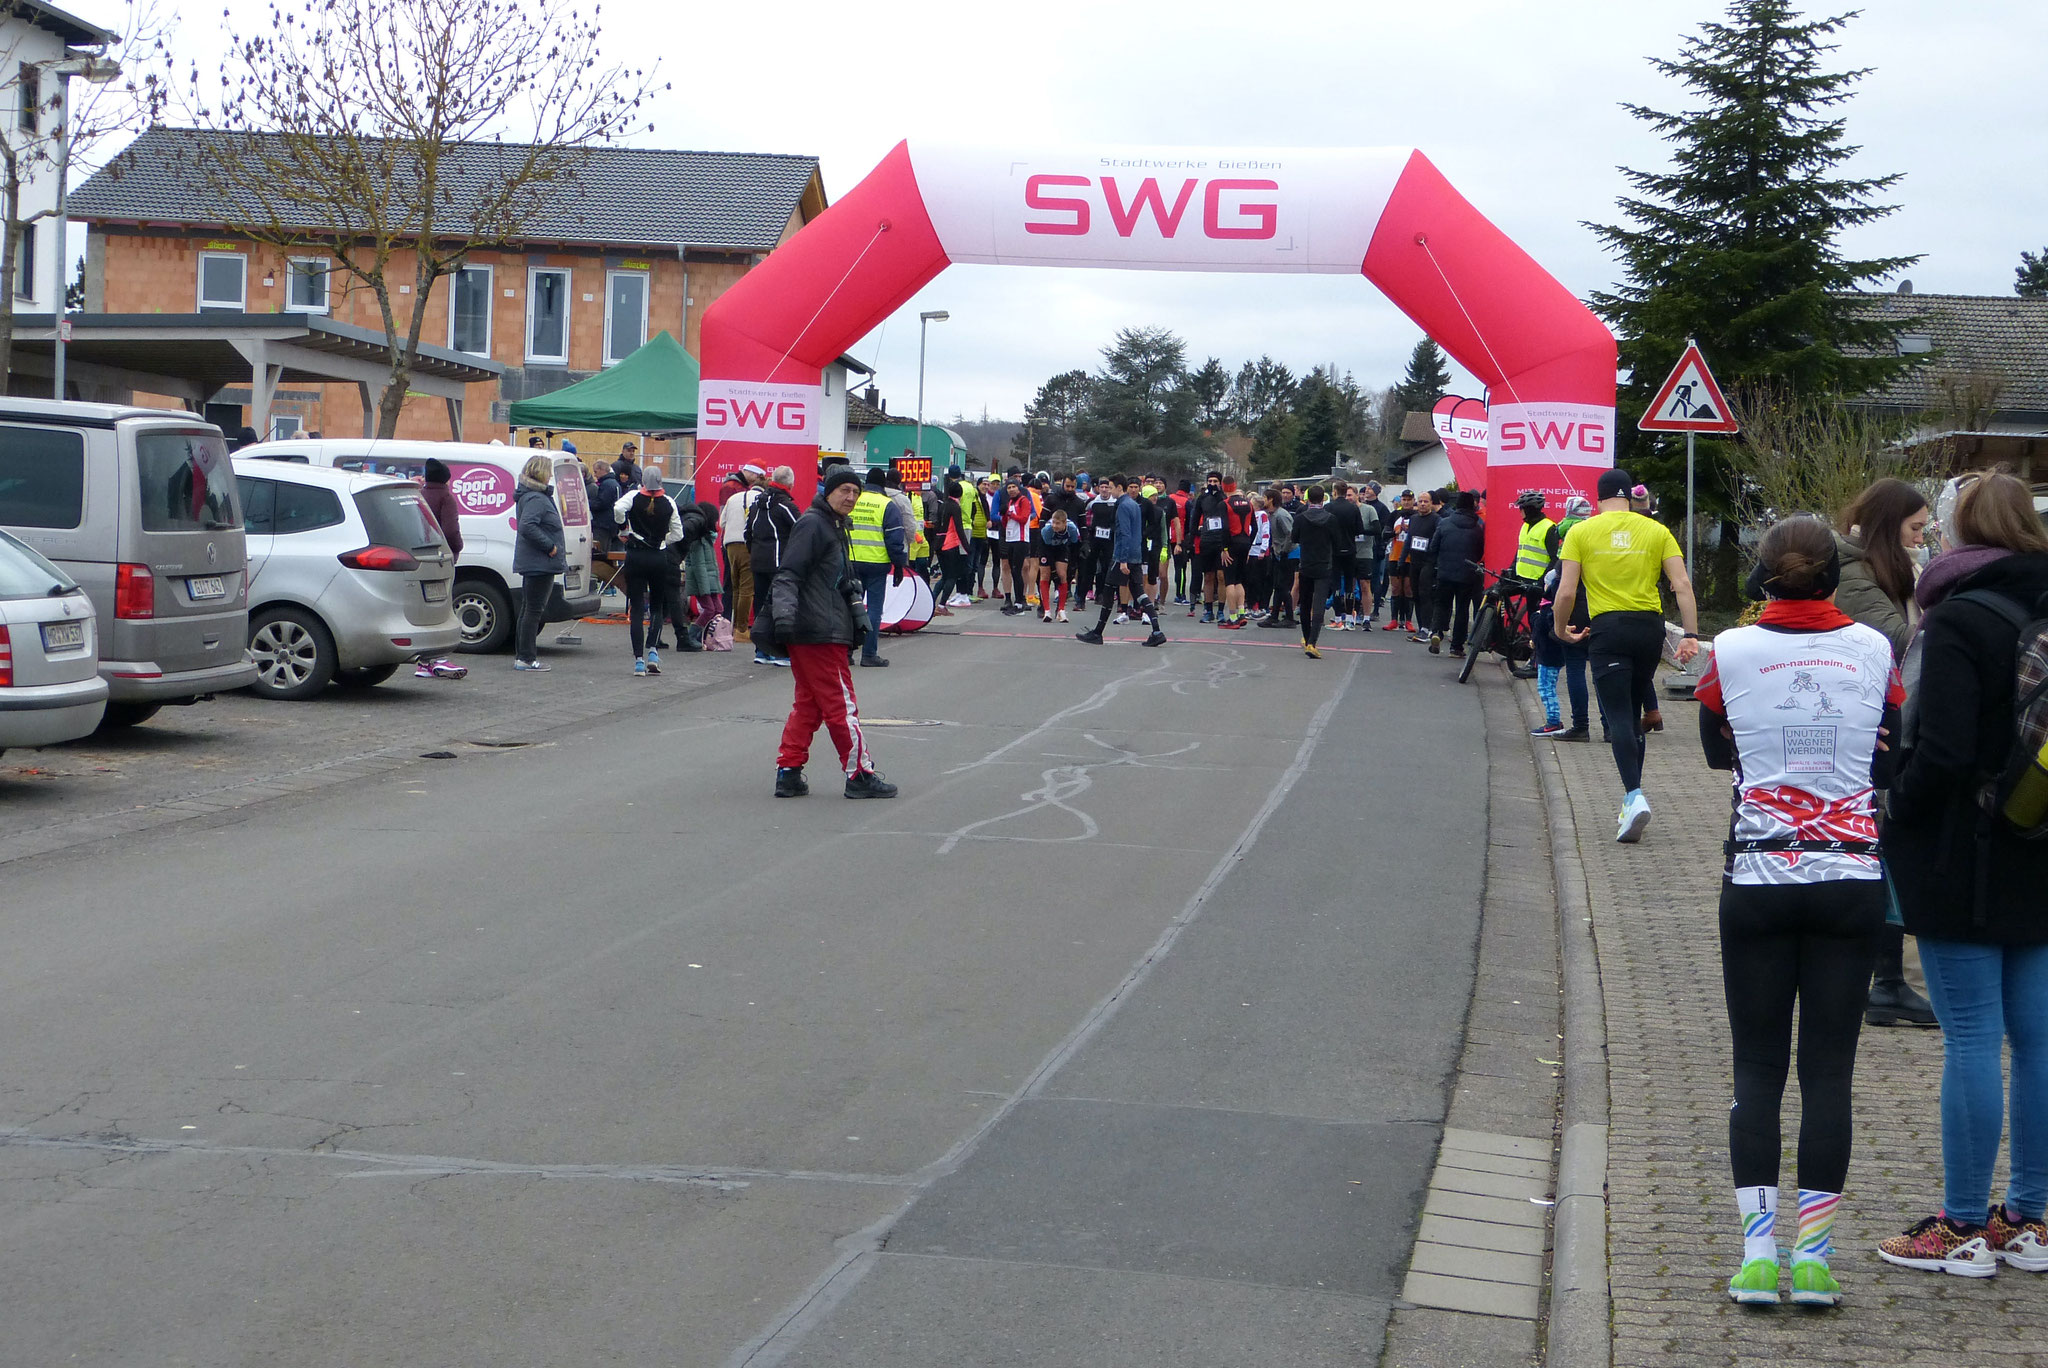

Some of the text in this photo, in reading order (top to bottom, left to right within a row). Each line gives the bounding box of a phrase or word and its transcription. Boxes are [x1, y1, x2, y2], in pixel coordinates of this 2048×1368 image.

[1100, 157, 1282, 170] Stadtwerke Gießen
[1024, 174, 1279, 240] SWG
[728, 388, 778, 398] Stadtwerke
[705, 398, 806, 431] SWG
[1527, 410, 1578, 418] Stadtwerke
[1500, 421, 1605, 453] SWG
[717, 463, 734, 471] MIT
[452, 476, 497, 497] Sport
[467, 491, 507, 508] Shop
[1613, 532, 1629, 540] HEY
[1759, 659, 1857, 674] team-naunheim.de
[1786, 728, 1834, 738] UNÜTZER
[1786, 738, 1833, 747] WAGNER
[1787, 747, 1833, 755] WERDING
